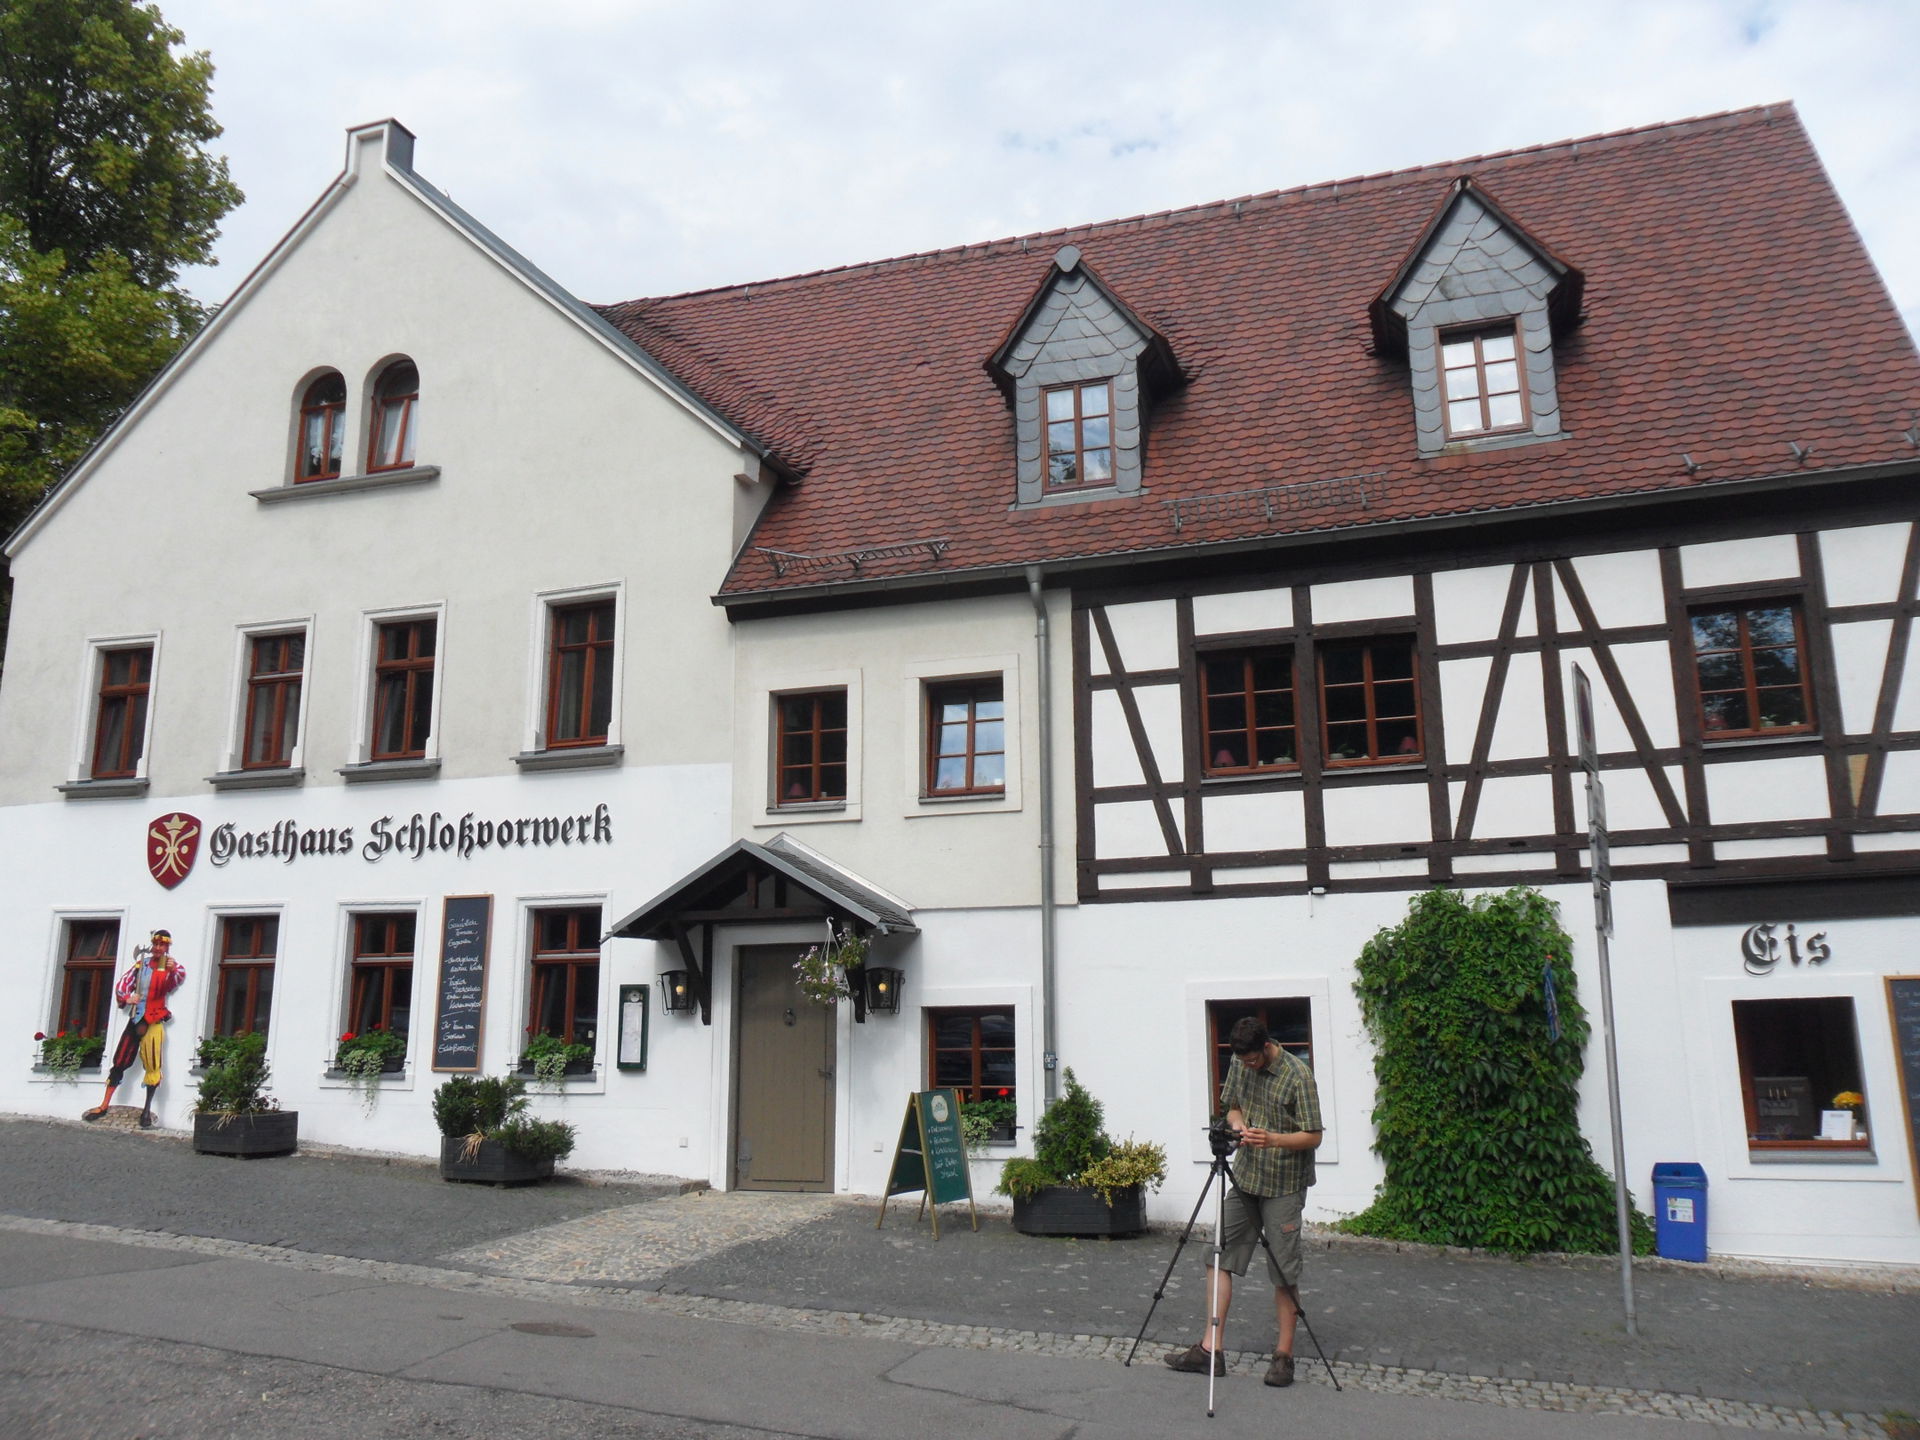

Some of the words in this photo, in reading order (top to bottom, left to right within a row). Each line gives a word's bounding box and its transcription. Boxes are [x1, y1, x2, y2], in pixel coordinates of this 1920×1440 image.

[210, 818, 353, 866] Gasthaus
[362, 803, 614, 862] Schloßvorwerk
[1741, 921, 1831, 975] Eis
